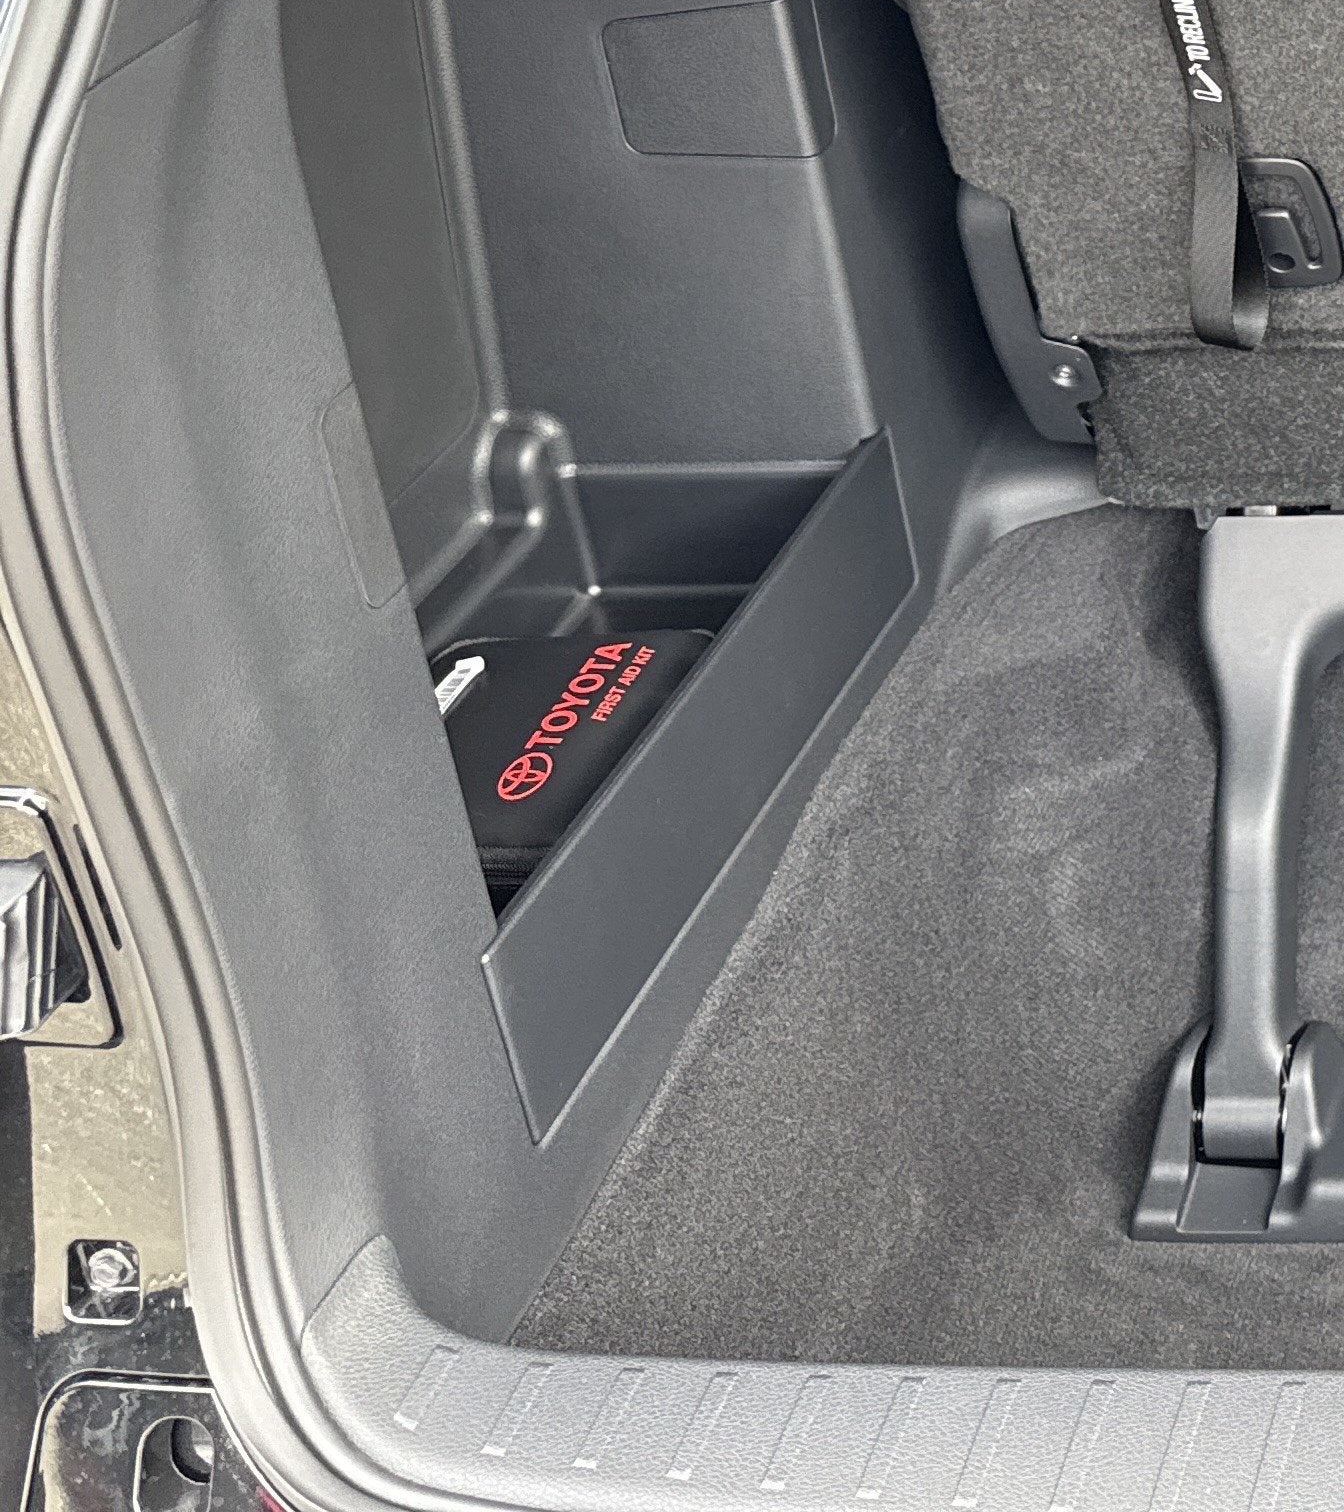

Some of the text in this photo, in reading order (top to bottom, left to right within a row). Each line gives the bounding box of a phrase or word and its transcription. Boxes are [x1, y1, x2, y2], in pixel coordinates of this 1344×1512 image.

[1185, 45, 1211, 62] TO
[524, 640, 634, 750] TOYOTA
[590, 645, 656, 722] FIRST AID KIT
